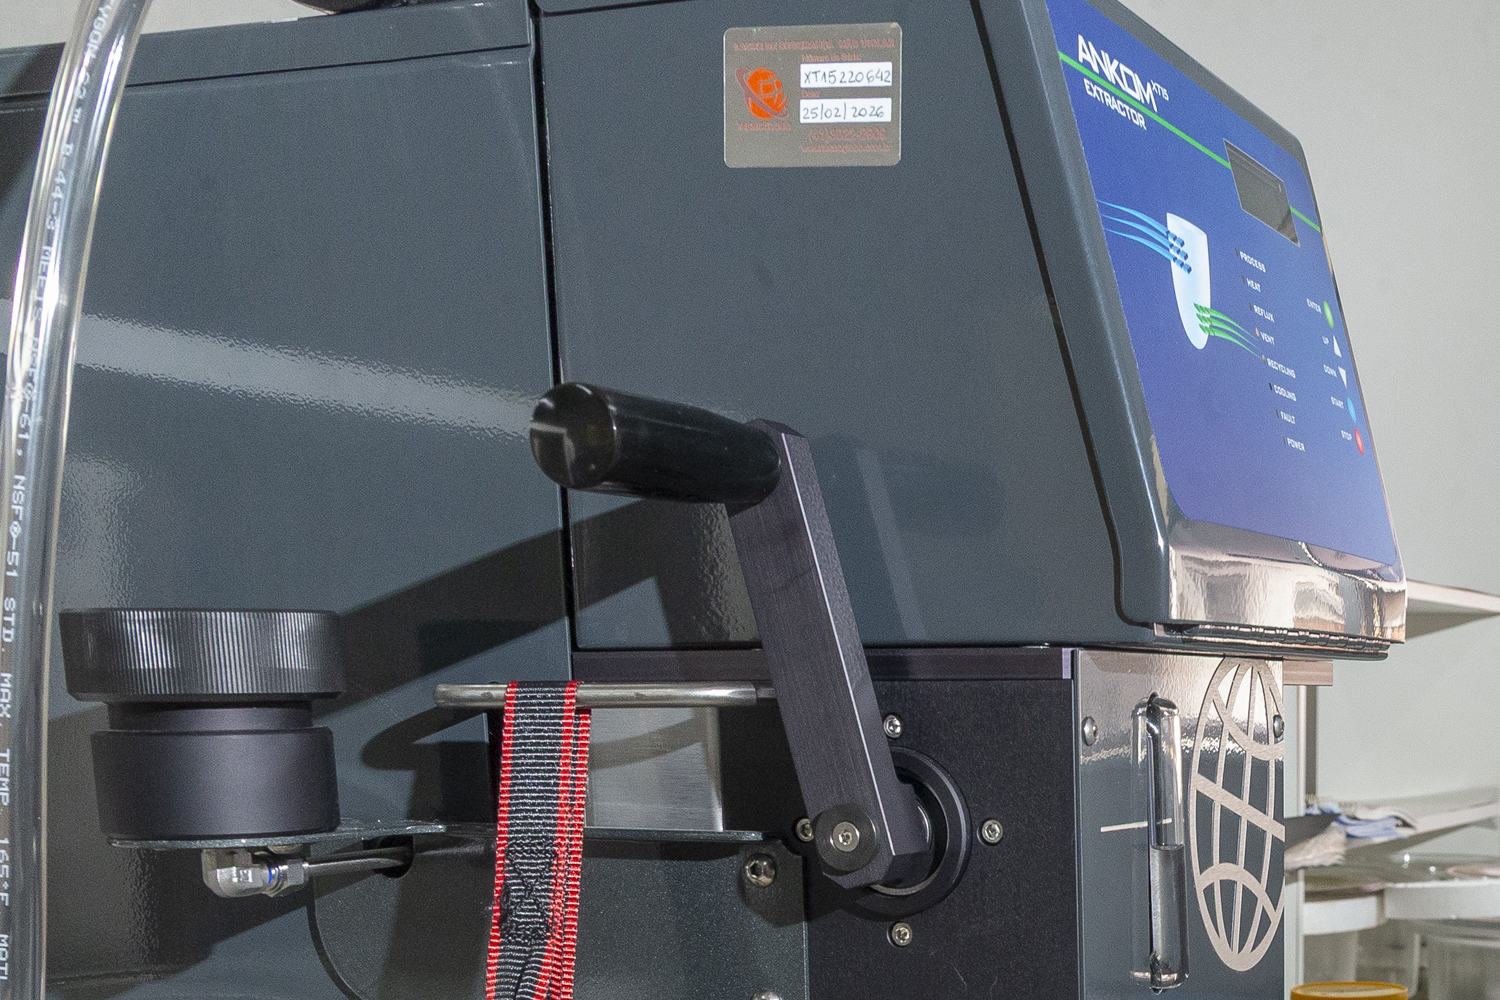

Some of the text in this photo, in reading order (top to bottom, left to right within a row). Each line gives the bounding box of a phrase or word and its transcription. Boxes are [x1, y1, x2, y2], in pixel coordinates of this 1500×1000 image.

[1077, 34, 1159, 112] ANKOM
[1083, 78, 1147, 131] EXTRACTOR
[1240, 251, 1266, 273] PROCESS
[1246, 277, 1261, 292] HEAT
[1253, 304, 1275, 322] REFLUX
[1306, 298, 1322, 314] ENTER
[1260, 330, 1275, 345] VENT
[1322, 335, 1330, 345] UP
[1267, 357, 1296, 379] RECYCLING
[1323, 364, 1338, 378] DOWN
[1273, 384, 1297, 402] COOLING
[1330, 396, 1344, 409] START
[1280, 410, 1296, 425] FAULT
[1340, 430, 1353, 441] STOP
[1286, 436, 1305, 452] POWER
